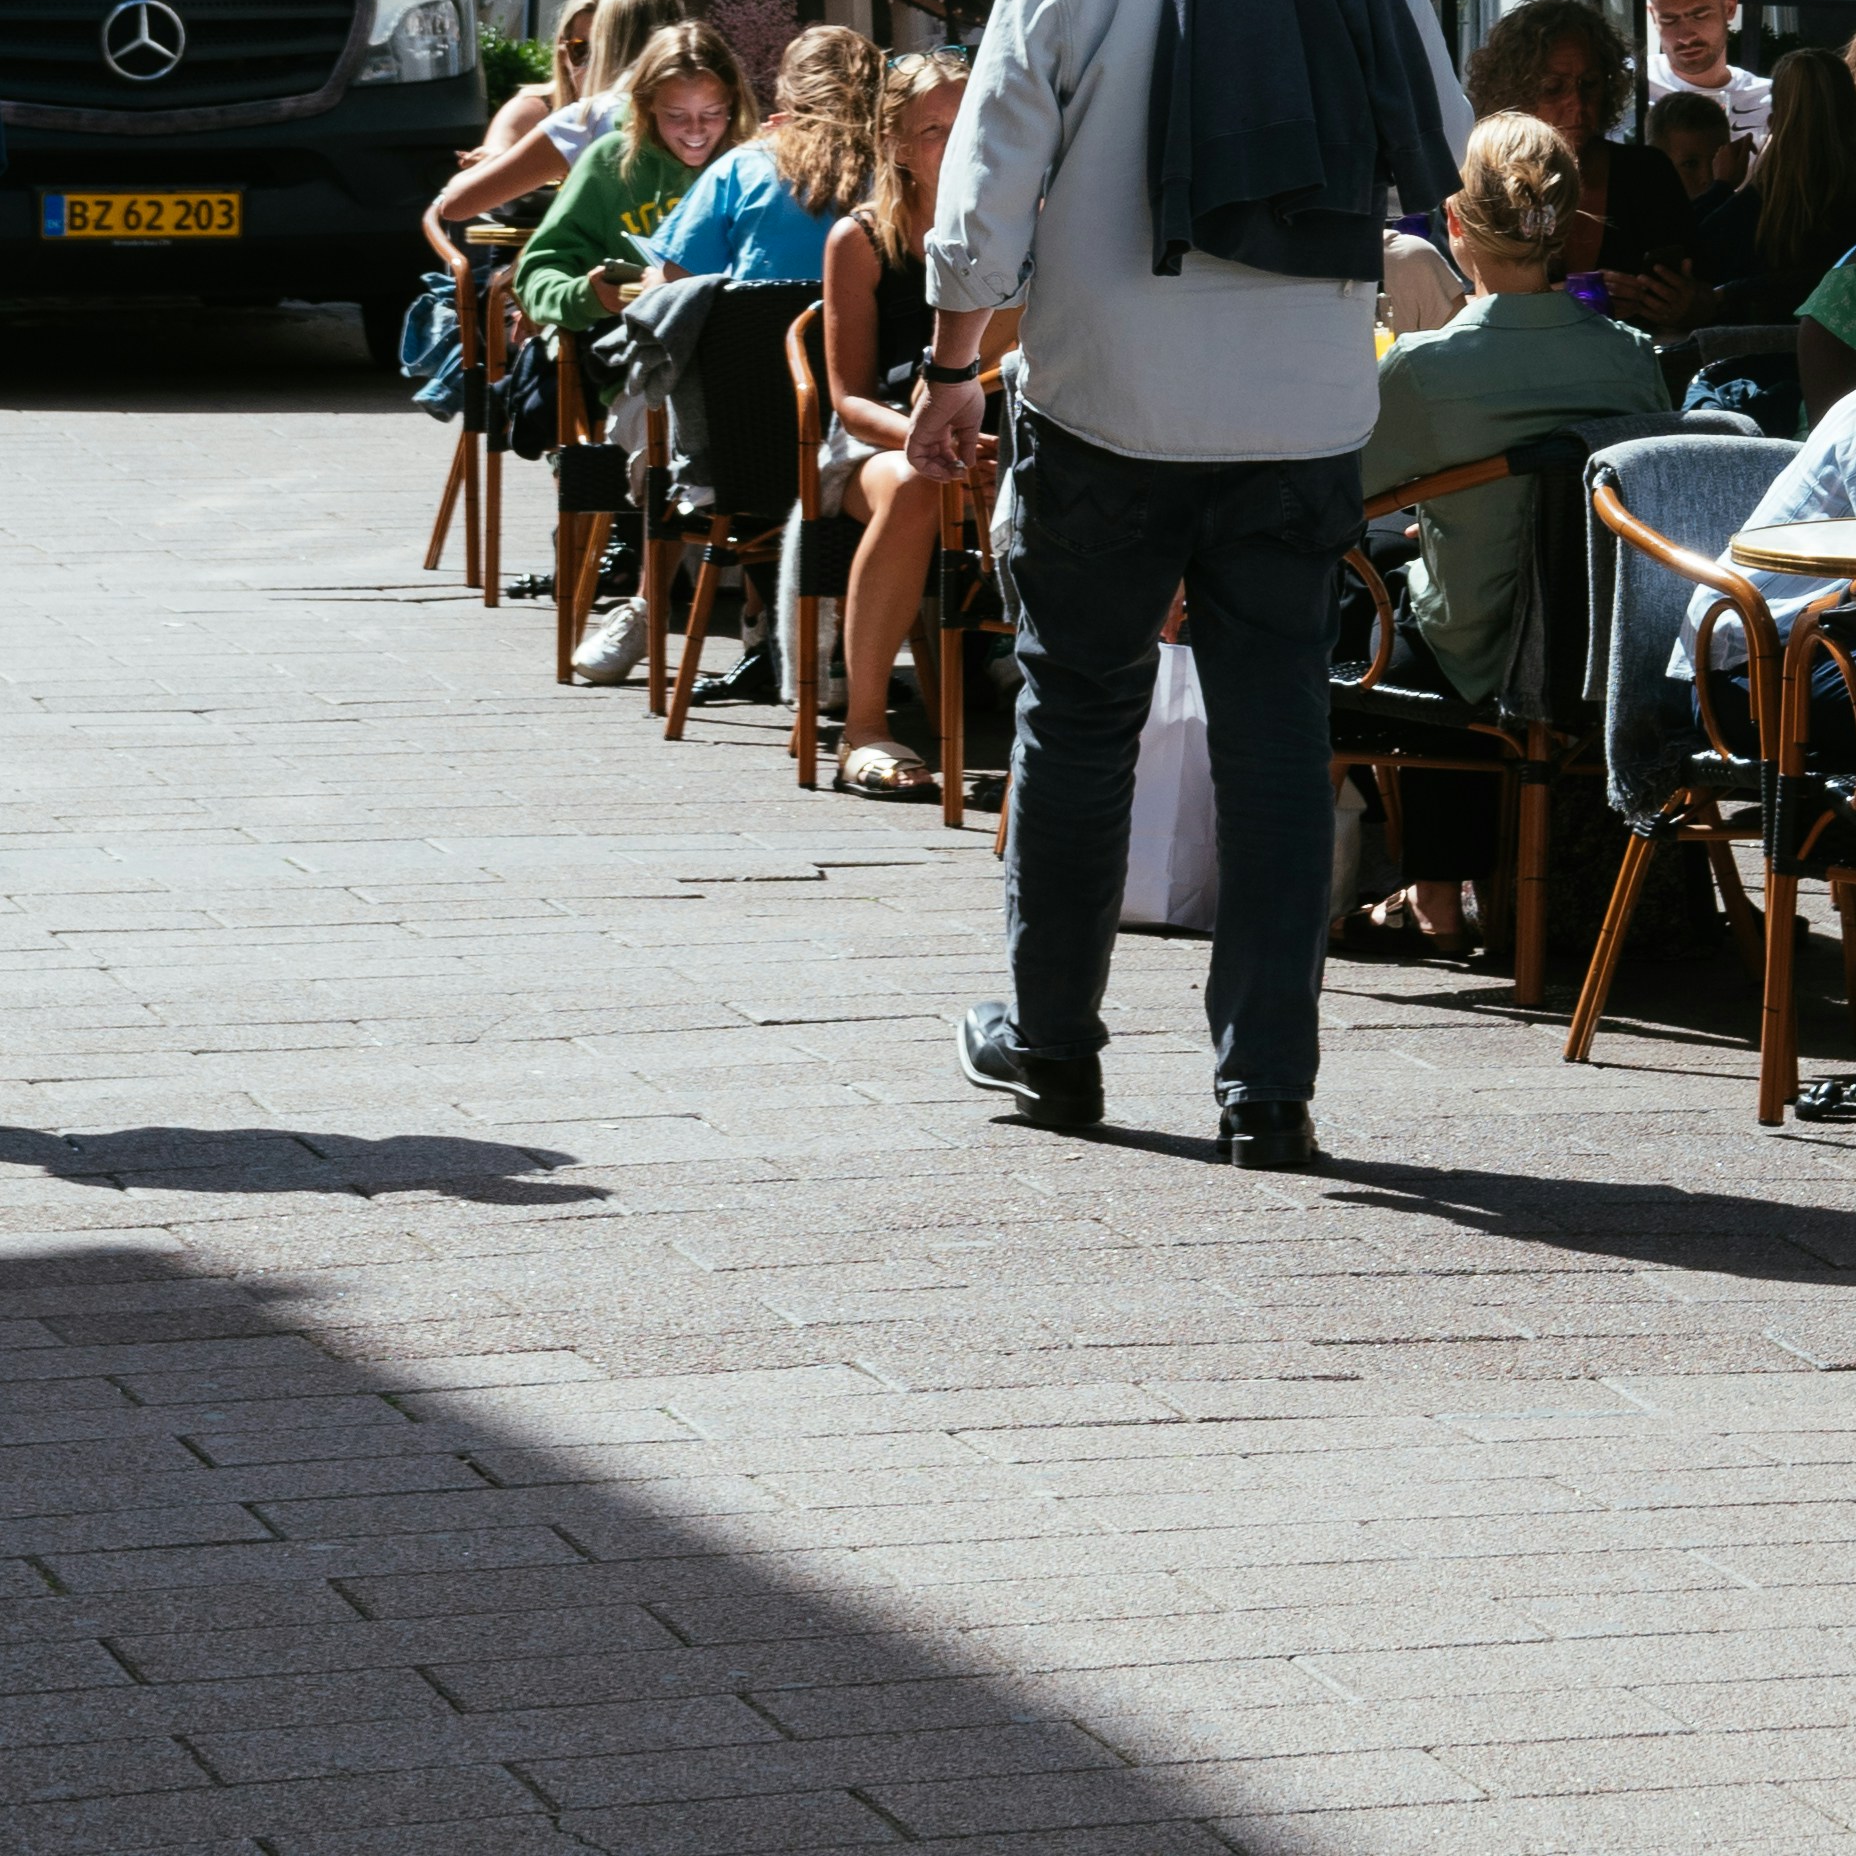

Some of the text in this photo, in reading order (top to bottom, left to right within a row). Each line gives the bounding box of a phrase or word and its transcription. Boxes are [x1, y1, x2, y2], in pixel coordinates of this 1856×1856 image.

[69, 200, 114, 231] BZ
[123, 198, 164, 231] 62
[173, 198, 235, 231] 203
